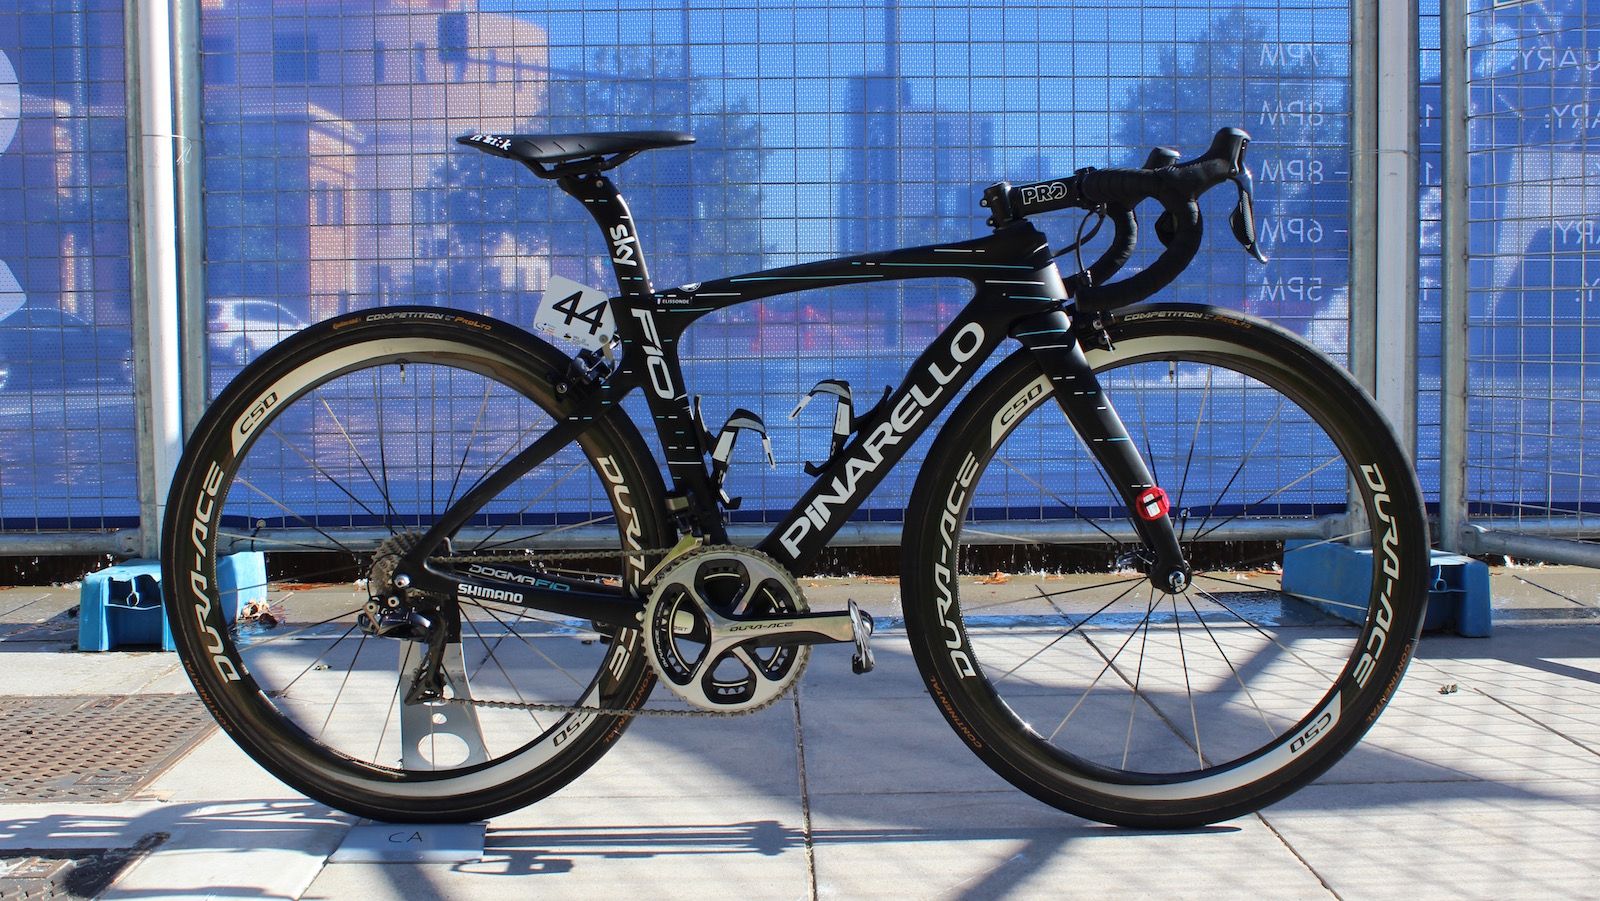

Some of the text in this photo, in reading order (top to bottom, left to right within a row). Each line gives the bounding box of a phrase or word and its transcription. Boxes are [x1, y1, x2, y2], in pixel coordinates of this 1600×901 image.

[1021, 182, 1068, 205] PRO
[609, 224, 637, 267] sky
[366, 311, 443, 322] COMPETITION
[552, 290, 608, 336] 44
[1124, 310, 1203, 322] COMPETITION
[631, 308, 675, 400] F10
[779, 321, 985, 559] PINARELLO
[190, 460, 242, 684] DURA-ACE
[935, 450, 980, 680] DURA-ACE
[1352, 462, 1400, 689] DURA-ACE
[458, 583, 524, 604] SHIMANO
[729, 621, 795, 632] DURA-ACE
